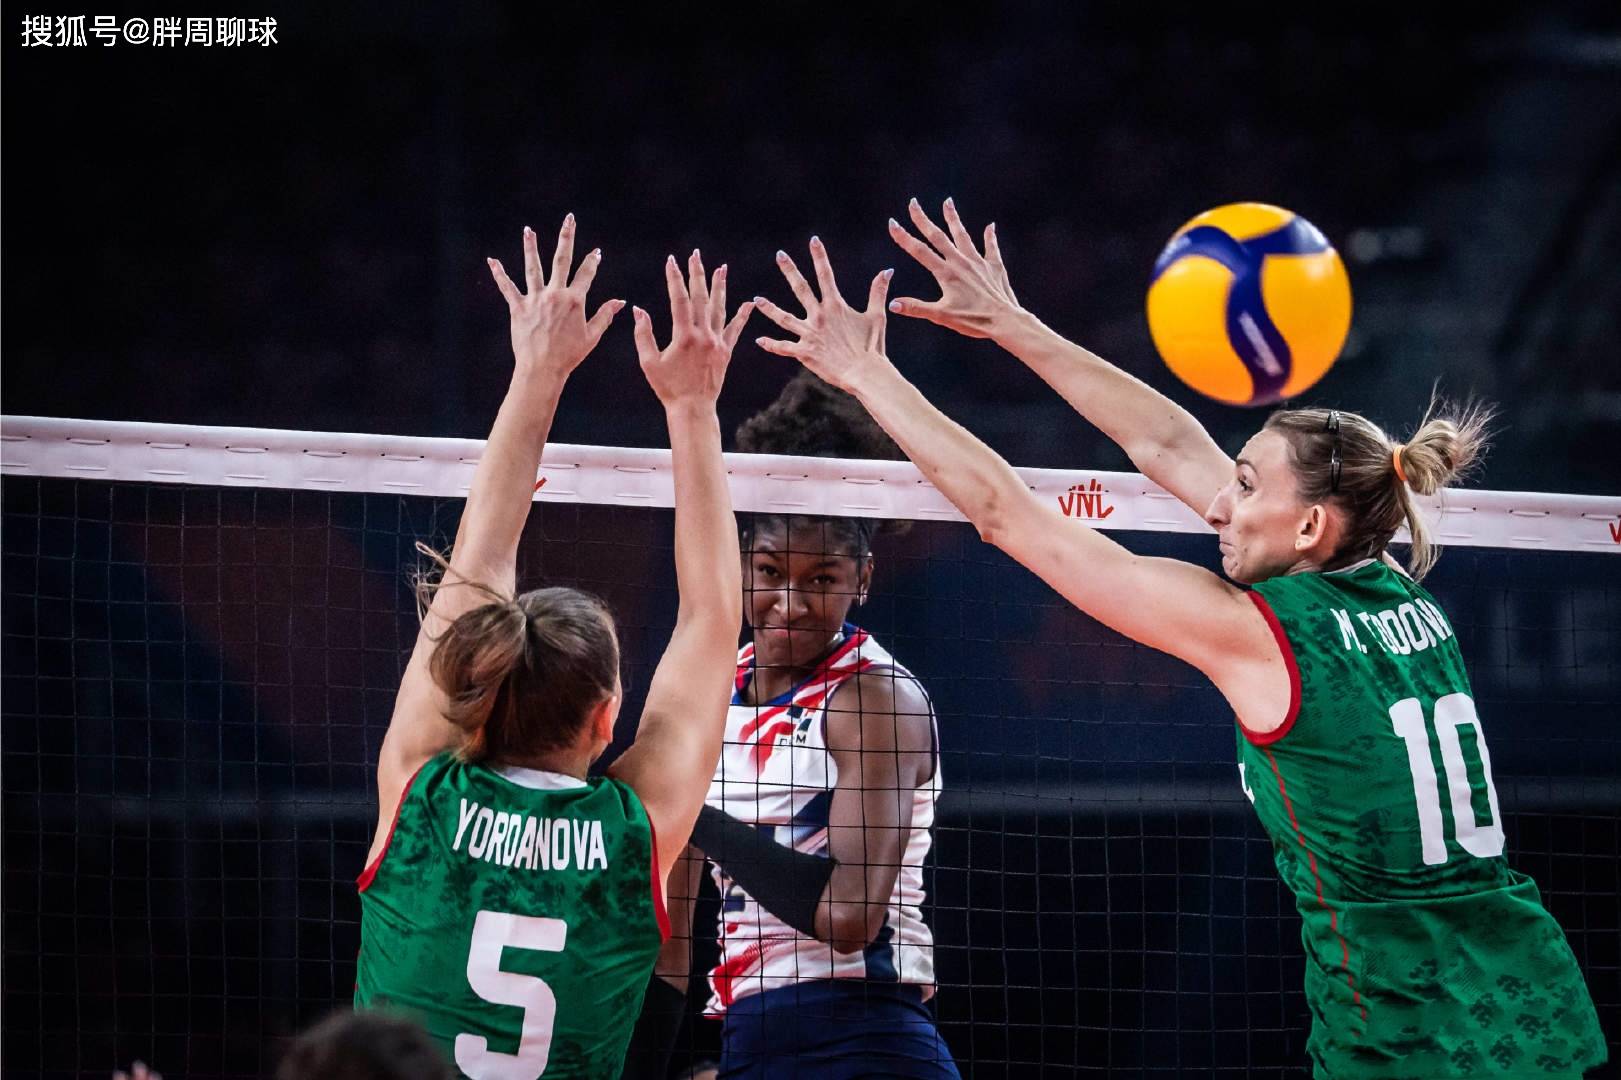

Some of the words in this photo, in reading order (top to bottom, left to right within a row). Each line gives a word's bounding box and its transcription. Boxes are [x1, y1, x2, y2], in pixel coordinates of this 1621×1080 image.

[1057, 478, 1115, 519] VNL
[452, 798, 608, 871] YORDANOVA
[1388, 692, 1506, 866] 10
[454, 909, 568, 1080] 5
